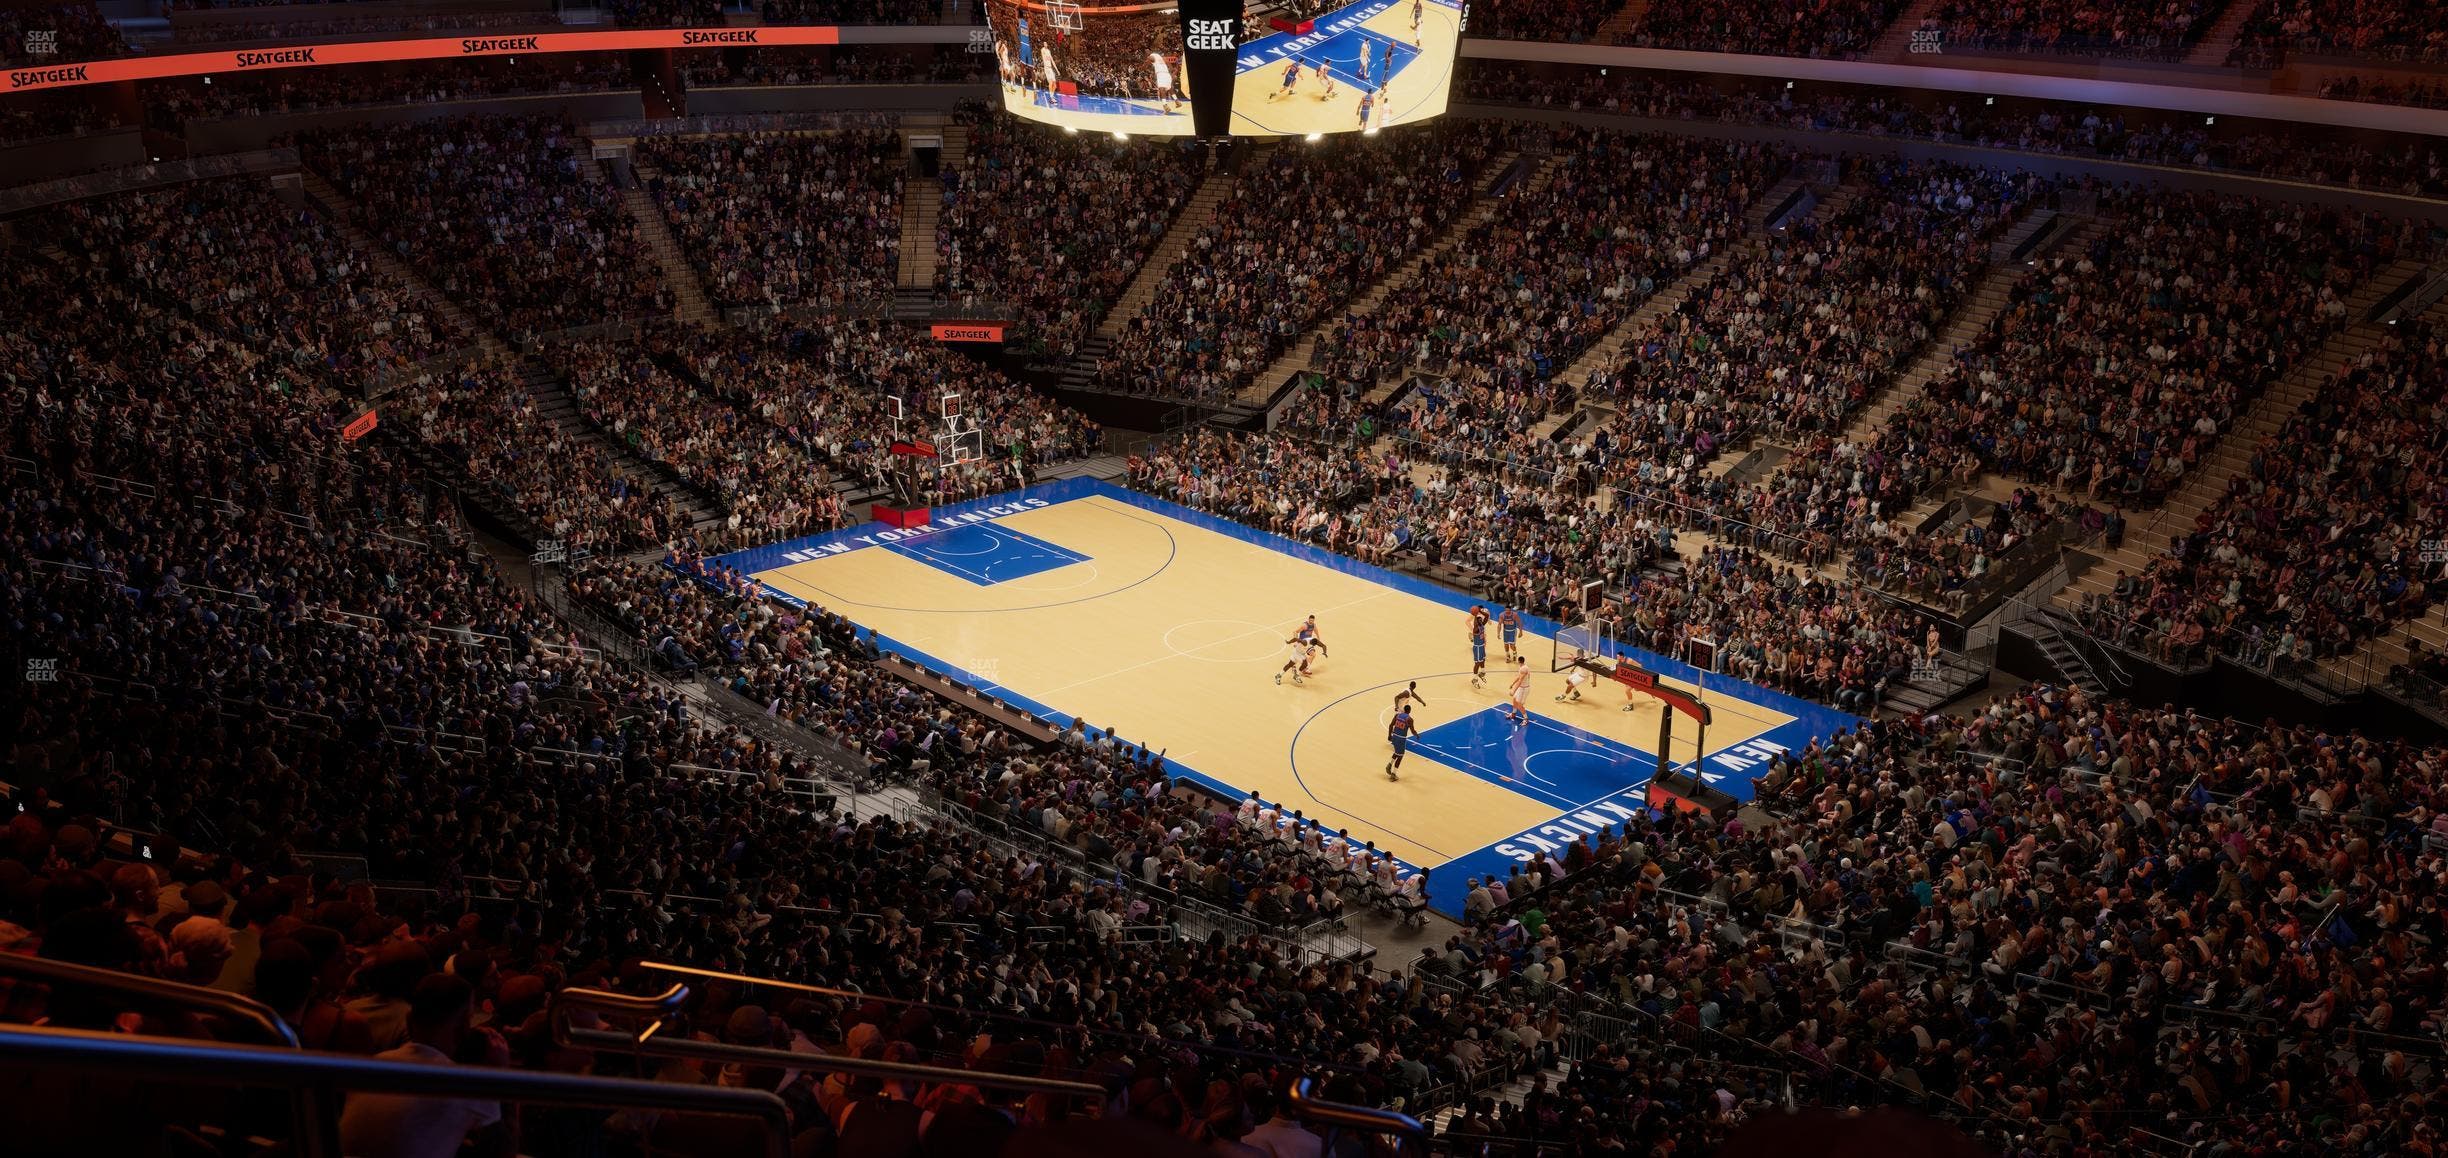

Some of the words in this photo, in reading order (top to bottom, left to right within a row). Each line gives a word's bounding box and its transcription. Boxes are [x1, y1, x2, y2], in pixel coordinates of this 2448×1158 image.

[1189, 18, 1234, 35] SEAT
[1265, 31, 1329, 56] YORK
[1326, 2, 1388, 34] KNICKS
[462, 36, 538, 53] SEATGEEK
[683, 30, 758, 44] SEATGEEK
[1187, 34, 1235, 50] GEEK
[237, 48, 314, 67] SEATGEEK
[10, 65, 88, 87] SEATGEEK
[944, 329, 991, 340] SEATGEEK
[782, 541, 852, 562] NEW
[854, 525, 940, 545] YORK
[938, 498, 1050, 527] KNICKS
[1710, 738, 1791, 772] NEW
[1494, 801, 1637, 862] KNICKS
